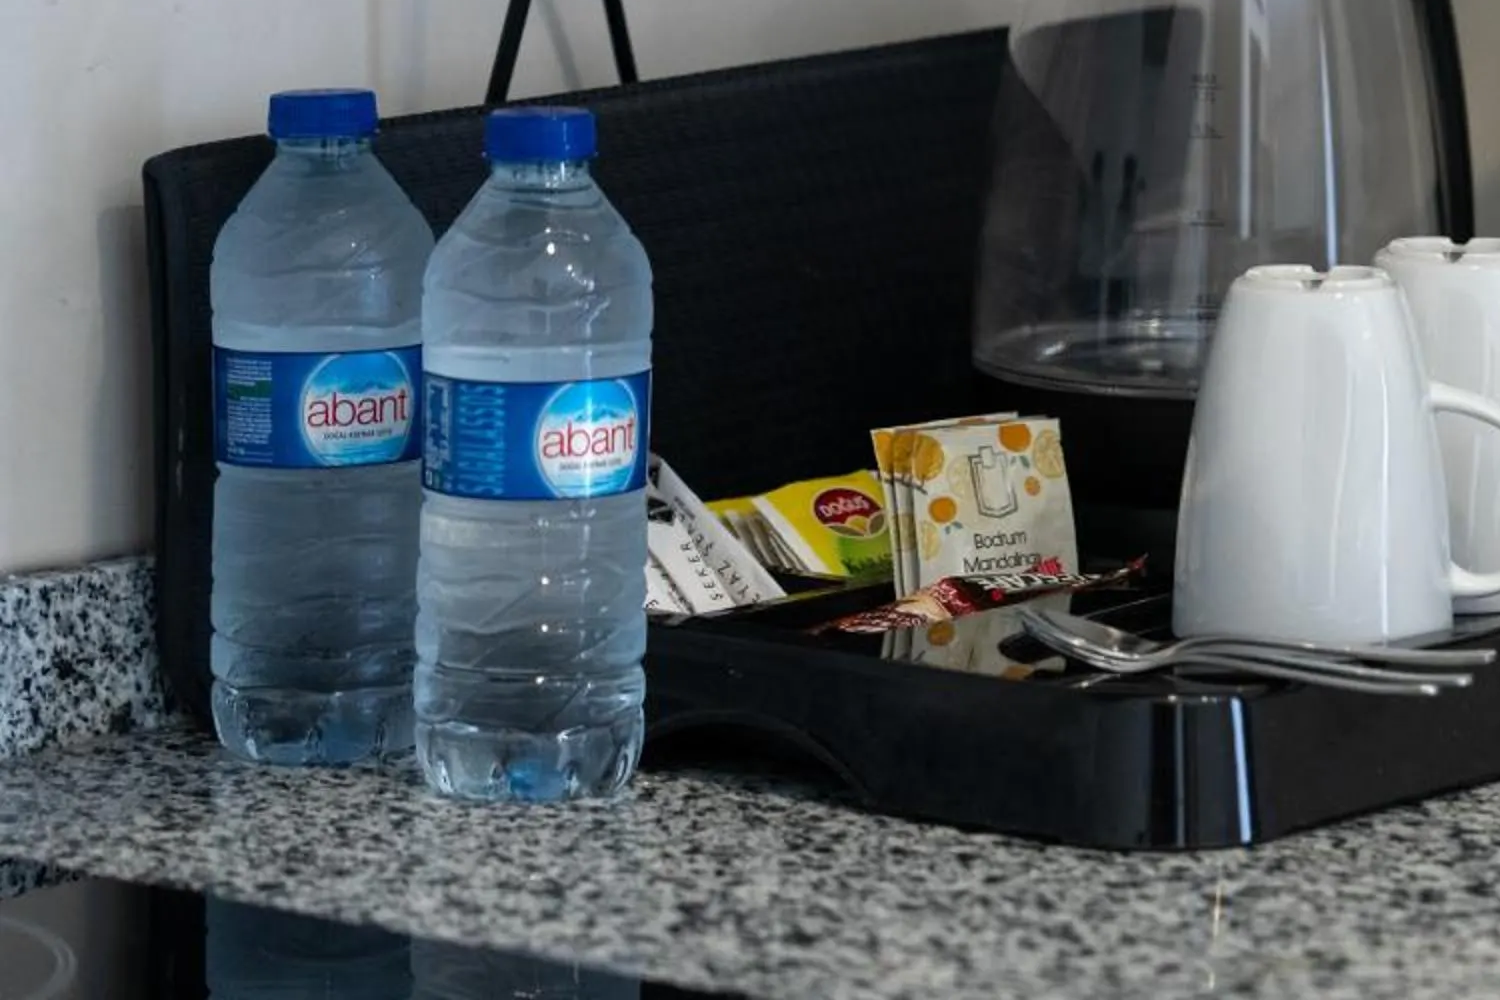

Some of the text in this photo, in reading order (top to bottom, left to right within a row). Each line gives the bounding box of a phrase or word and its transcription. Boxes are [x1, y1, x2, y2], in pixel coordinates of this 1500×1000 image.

[307, 390, 407, 428] abant
[458, 383, 505, 495] SAGALASSOS
[543, 418, 633, 459] abant
[973, 530, 1027, 549] Bodrum
